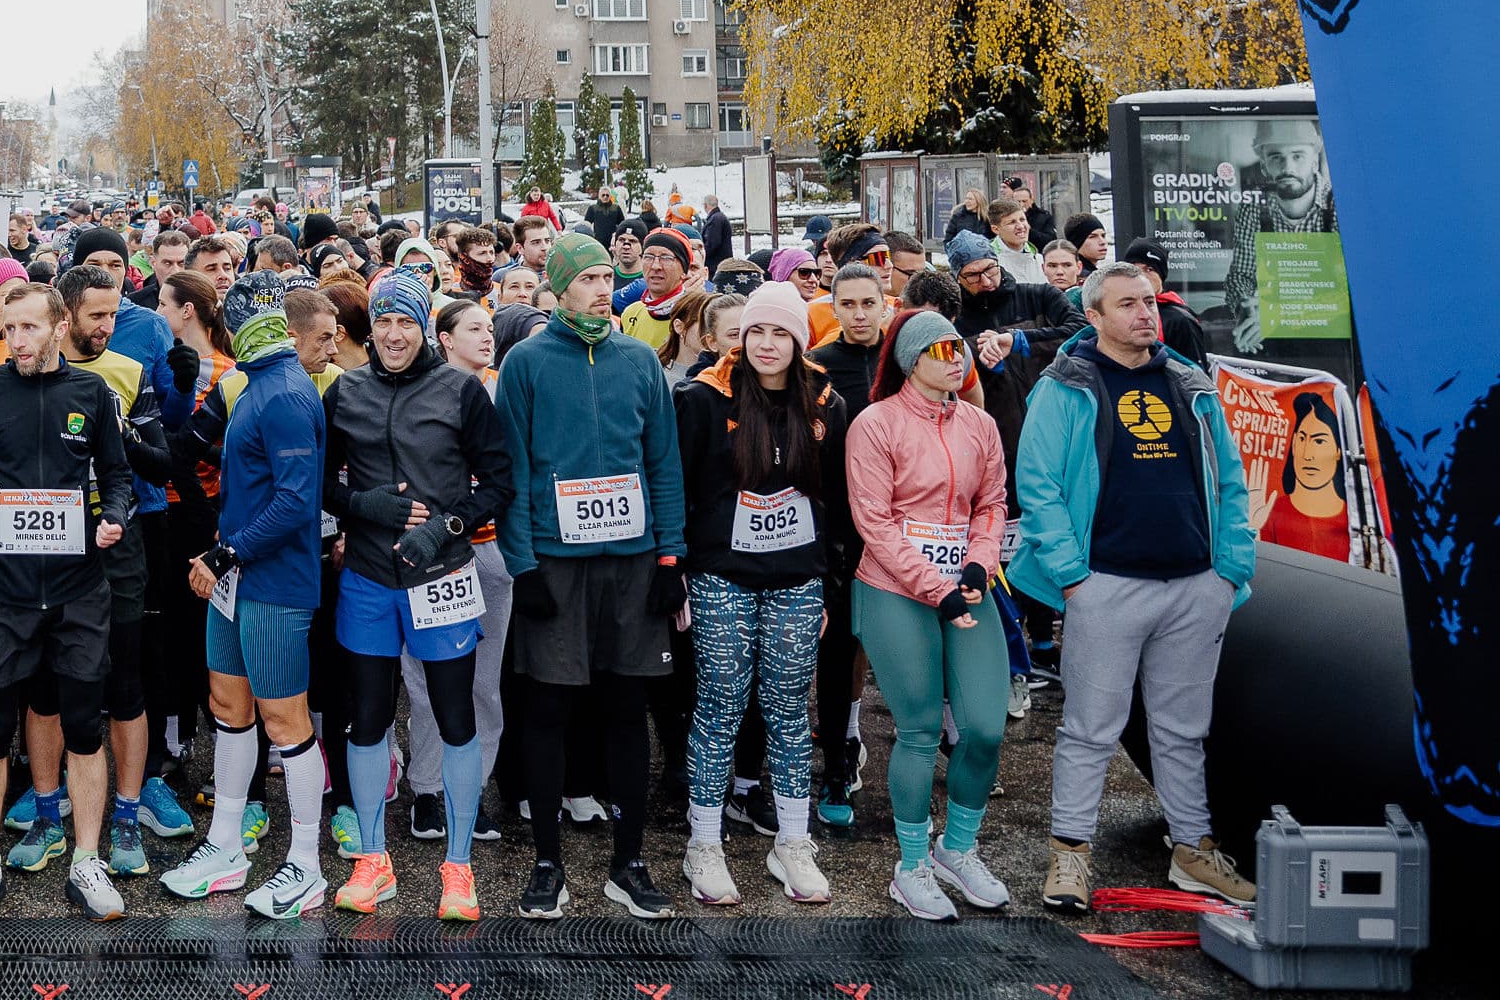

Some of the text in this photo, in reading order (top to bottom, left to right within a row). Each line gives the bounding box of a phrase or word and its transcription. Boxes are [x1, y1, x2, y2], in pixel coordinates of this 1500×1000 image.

[1149, 133, 1191, 143] POMGRAD
[1152, 173, 1237, 187] GRADIMO
[433, 188, 470, 197] GLEDAJ
[1153, 187, 1267, 204] BUDUĆNOST.
[1154, 207, 1228, 222] I TVOJU.
[1154, 229, 1192, 239] Postanite
[1177, 240, 1187, 249] od
[576, 496, 630, 520] 5013
[12, 510, 67, 531] 5281
[578, 519, 632, 530] ELZAR RAHMAN
[749, 506, 799, 532] 5052
[15, 533, 44, 541] MIRNES
[426, 575, 473, 604] 5357
[432, 605, 451, 614] ENES
[1318, 858, 1328, 899] MYLAPS
